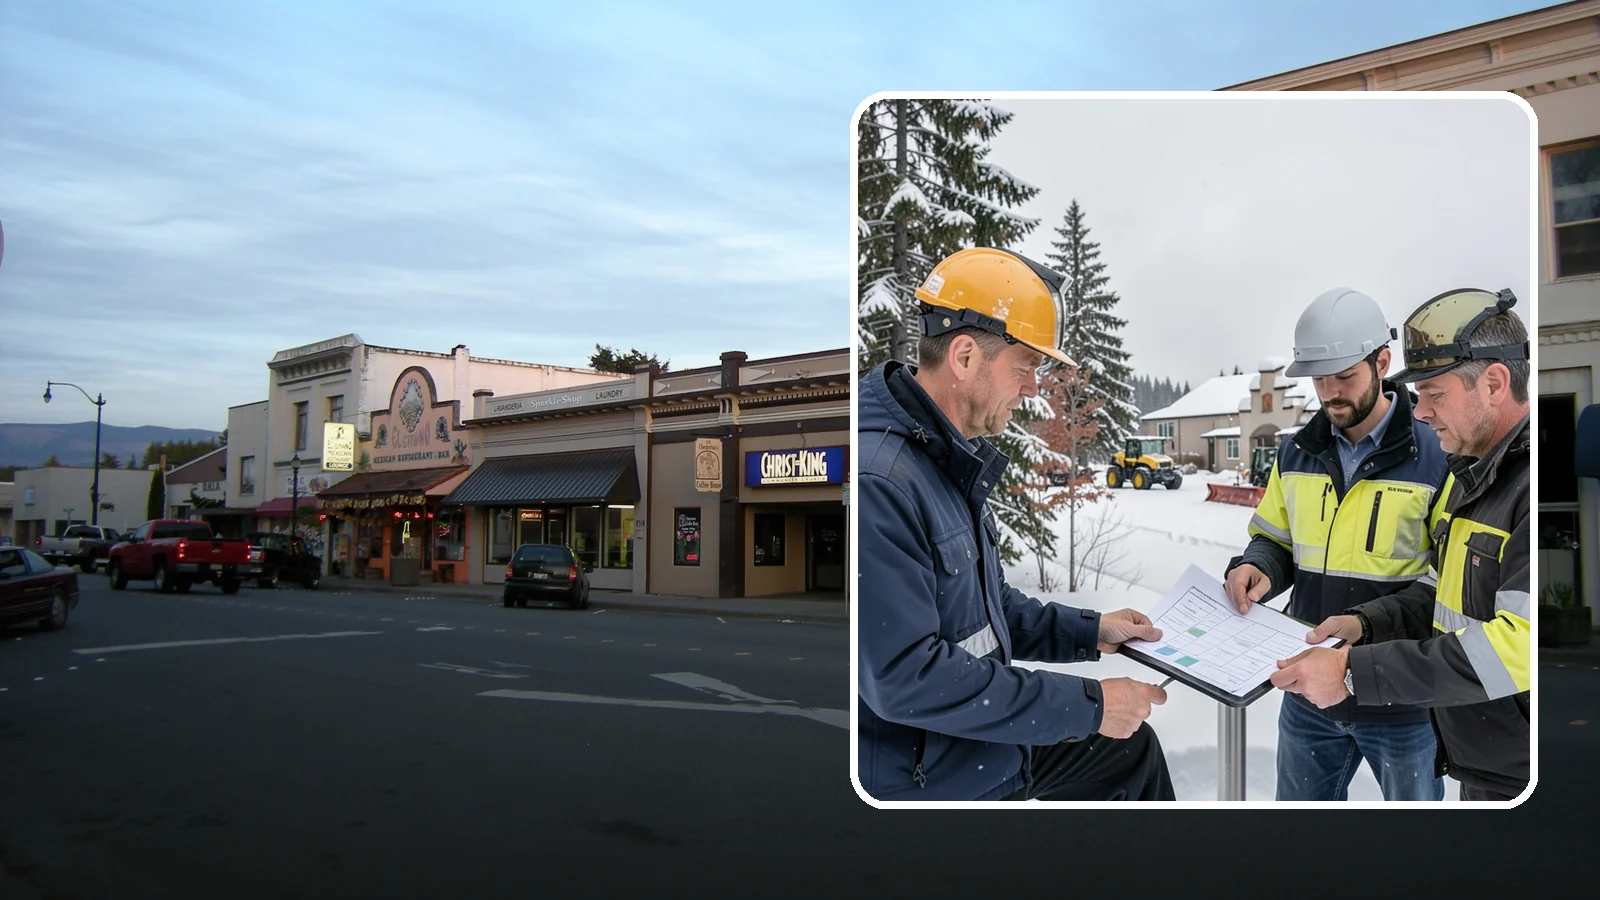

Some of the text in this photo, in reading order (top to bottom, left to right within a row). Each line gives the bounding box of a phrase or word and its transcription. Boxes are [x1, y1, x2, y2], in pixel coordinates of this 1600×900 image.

[596, 389, 624, 400] LAUNDRY
[493, 402, 522, 412] LAVANDERIA
[531, 395, 583, 408] Sparkle Shop
[374, 454, 397, 464] MEXICAN
[397, 451, 433, 462] RESTAURANT
[438, 450, 450, 459] BAR
[761, 450, 828, 478] CHRIST KING
